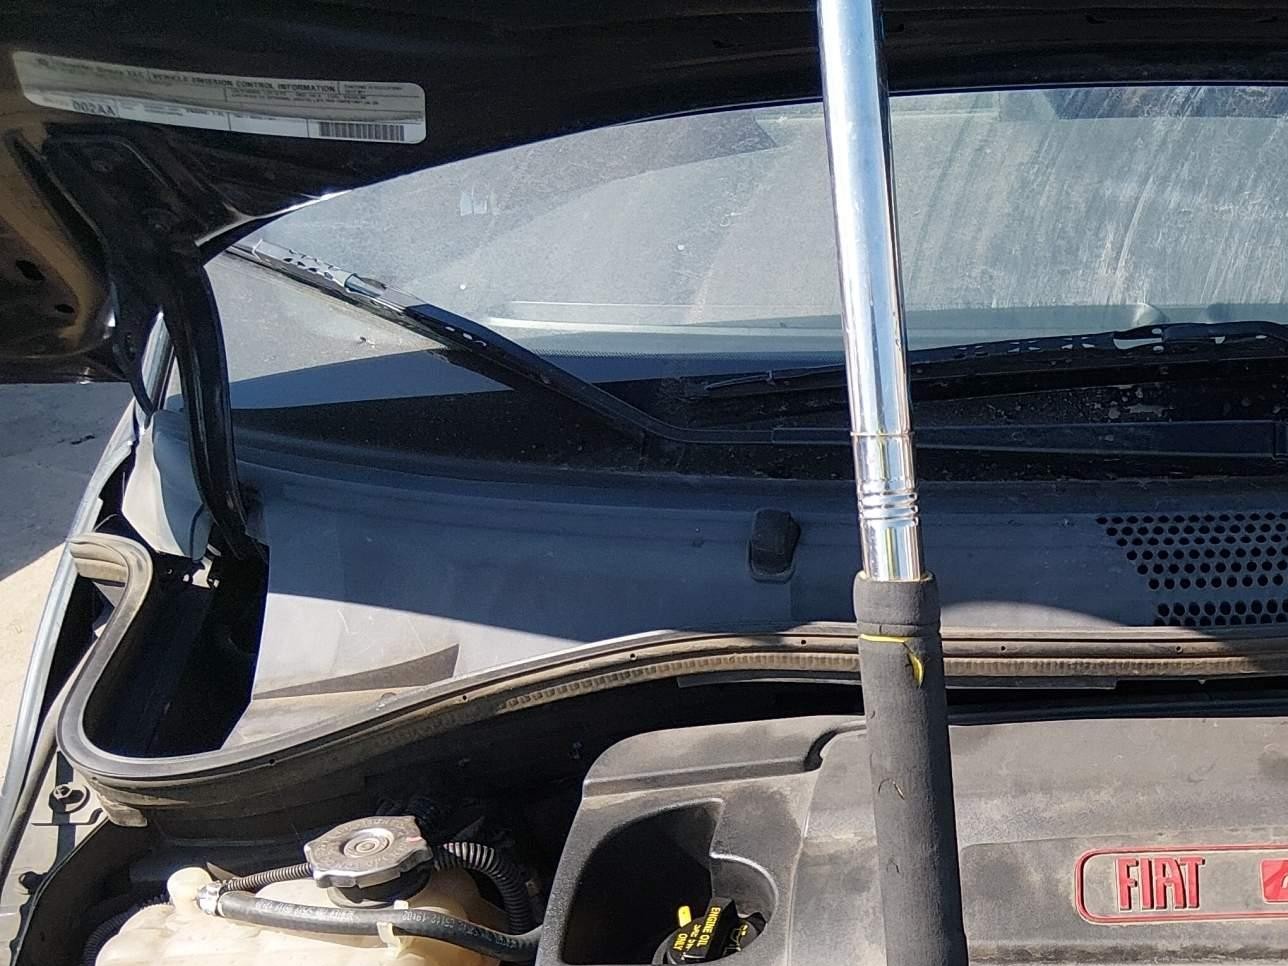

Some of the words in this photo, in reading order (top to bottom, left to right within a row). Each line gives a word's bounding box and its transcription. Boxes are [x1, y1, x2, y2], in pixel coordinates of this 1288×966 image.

[1115, 856, 1206, 912] FIAT
[702, 906, 721, 934] ENGINE
[672, 933, 689, 951] ONLY
[696, 934, 710, 948] OIL
